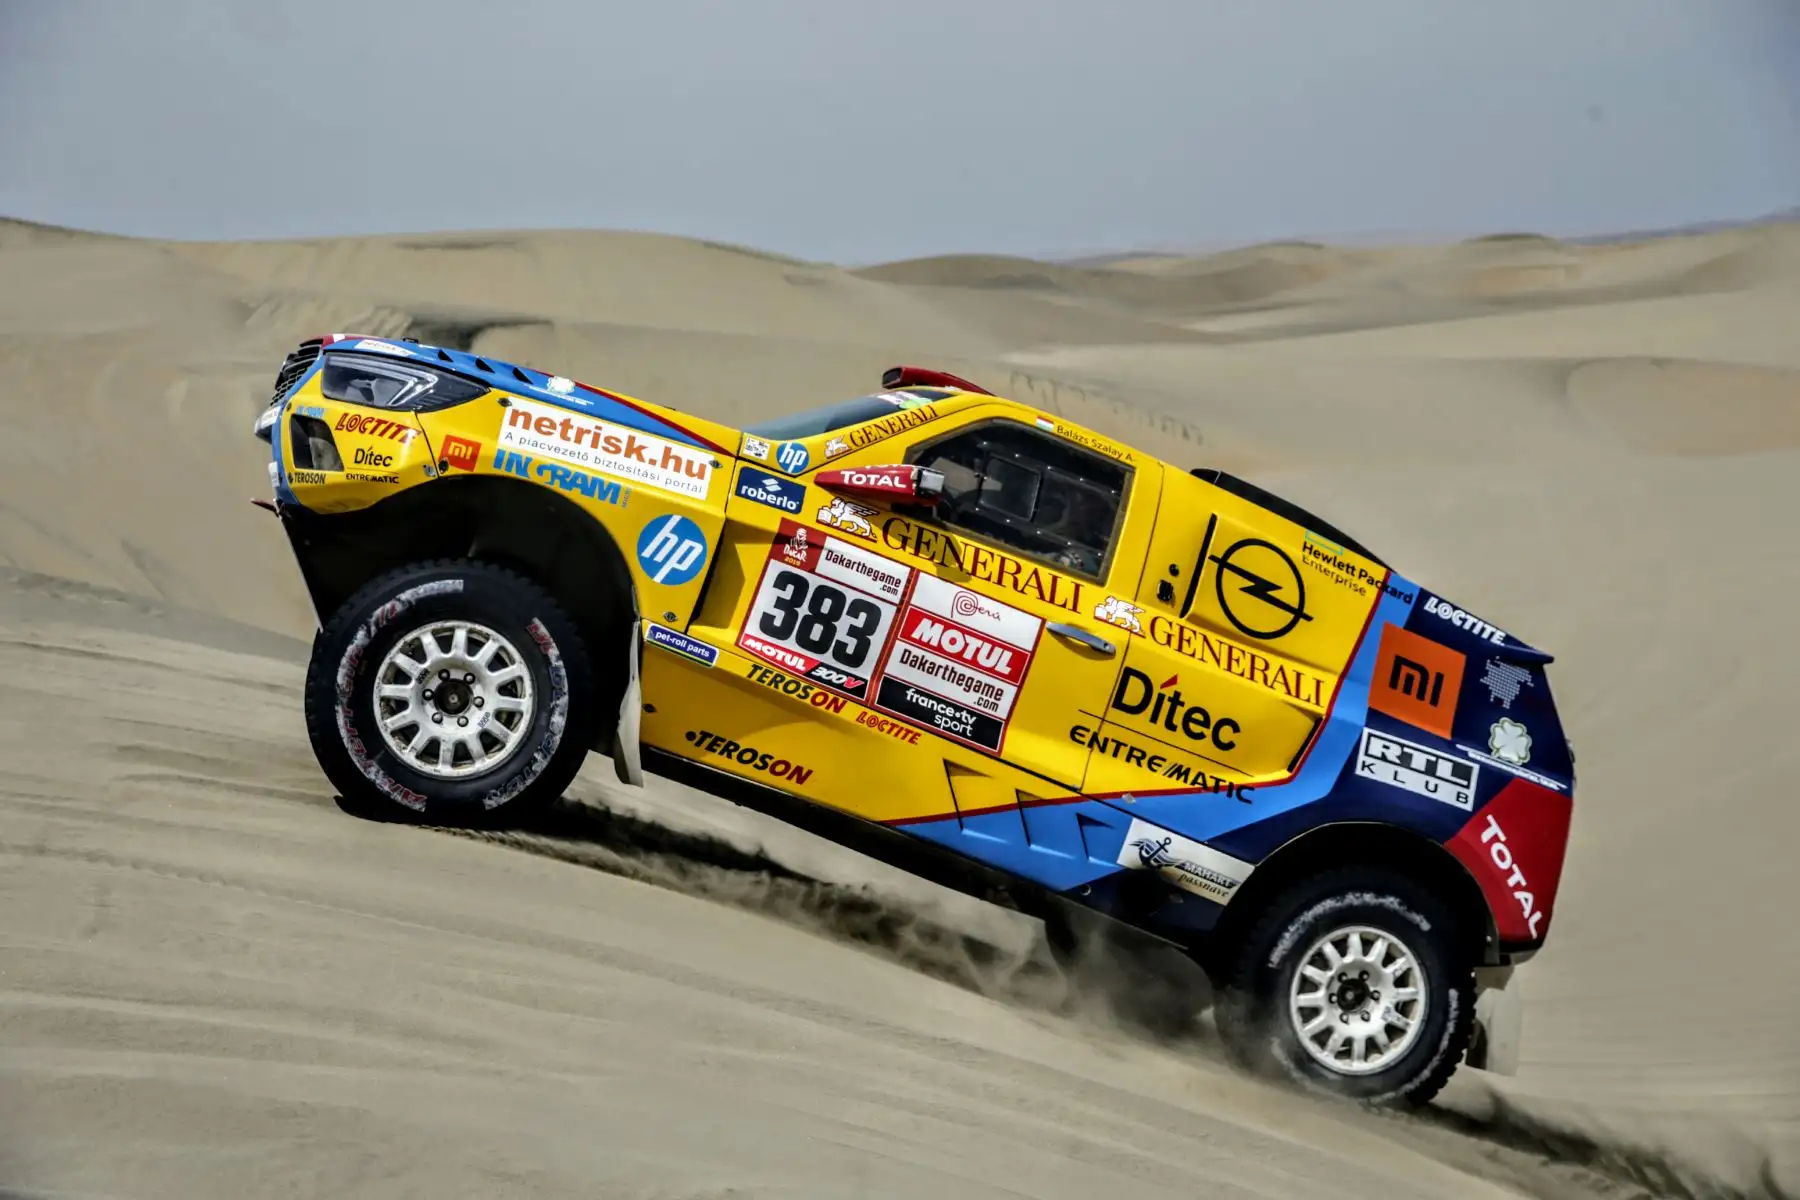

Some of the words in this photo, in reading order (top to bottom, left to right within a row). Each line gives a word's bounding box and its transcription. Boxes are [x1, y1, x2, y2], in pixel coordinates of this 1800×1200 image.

[504, 431, 514, 440] A
[508, 408, 708, 480] netrisk.hu
[849, 405, 939, 448] GENERALI
[778, 442, 808, 474] hp
[839, 470, 907, 489] TOTAL
[741, 485, 797, 510] roberlo
[640, 515, 704, 583] hp
[825, 549, 901, 588] Dakarthegame
[882, 517, 1083, 614] GENERALI
[1302, 541, 1356, 577] Hewlett
[1358, 568, 1414, 605] Packard
[1302, 555, 1367, 597] Enterprise
[759, 570, 882, 668] 383
[1424, 597, 1507, 646] LOCTITE
[687, 642, 711, 658] parts
[743, 638, 807, 671] MOTUL
[911, 617, 1014, 676] MOTUL
[1150, 616, 1325, 708] GENERALI
[745, 663, 849, 715] TEROSON
[810, 666, 866, 690] 300V
[899, 648, 1004, 701] Dakarthegame
[934, 713, 974, 738] sport
[1367, 735, 1470, 788] RTL
[1481, 814, 1543, 939] TOTAL
